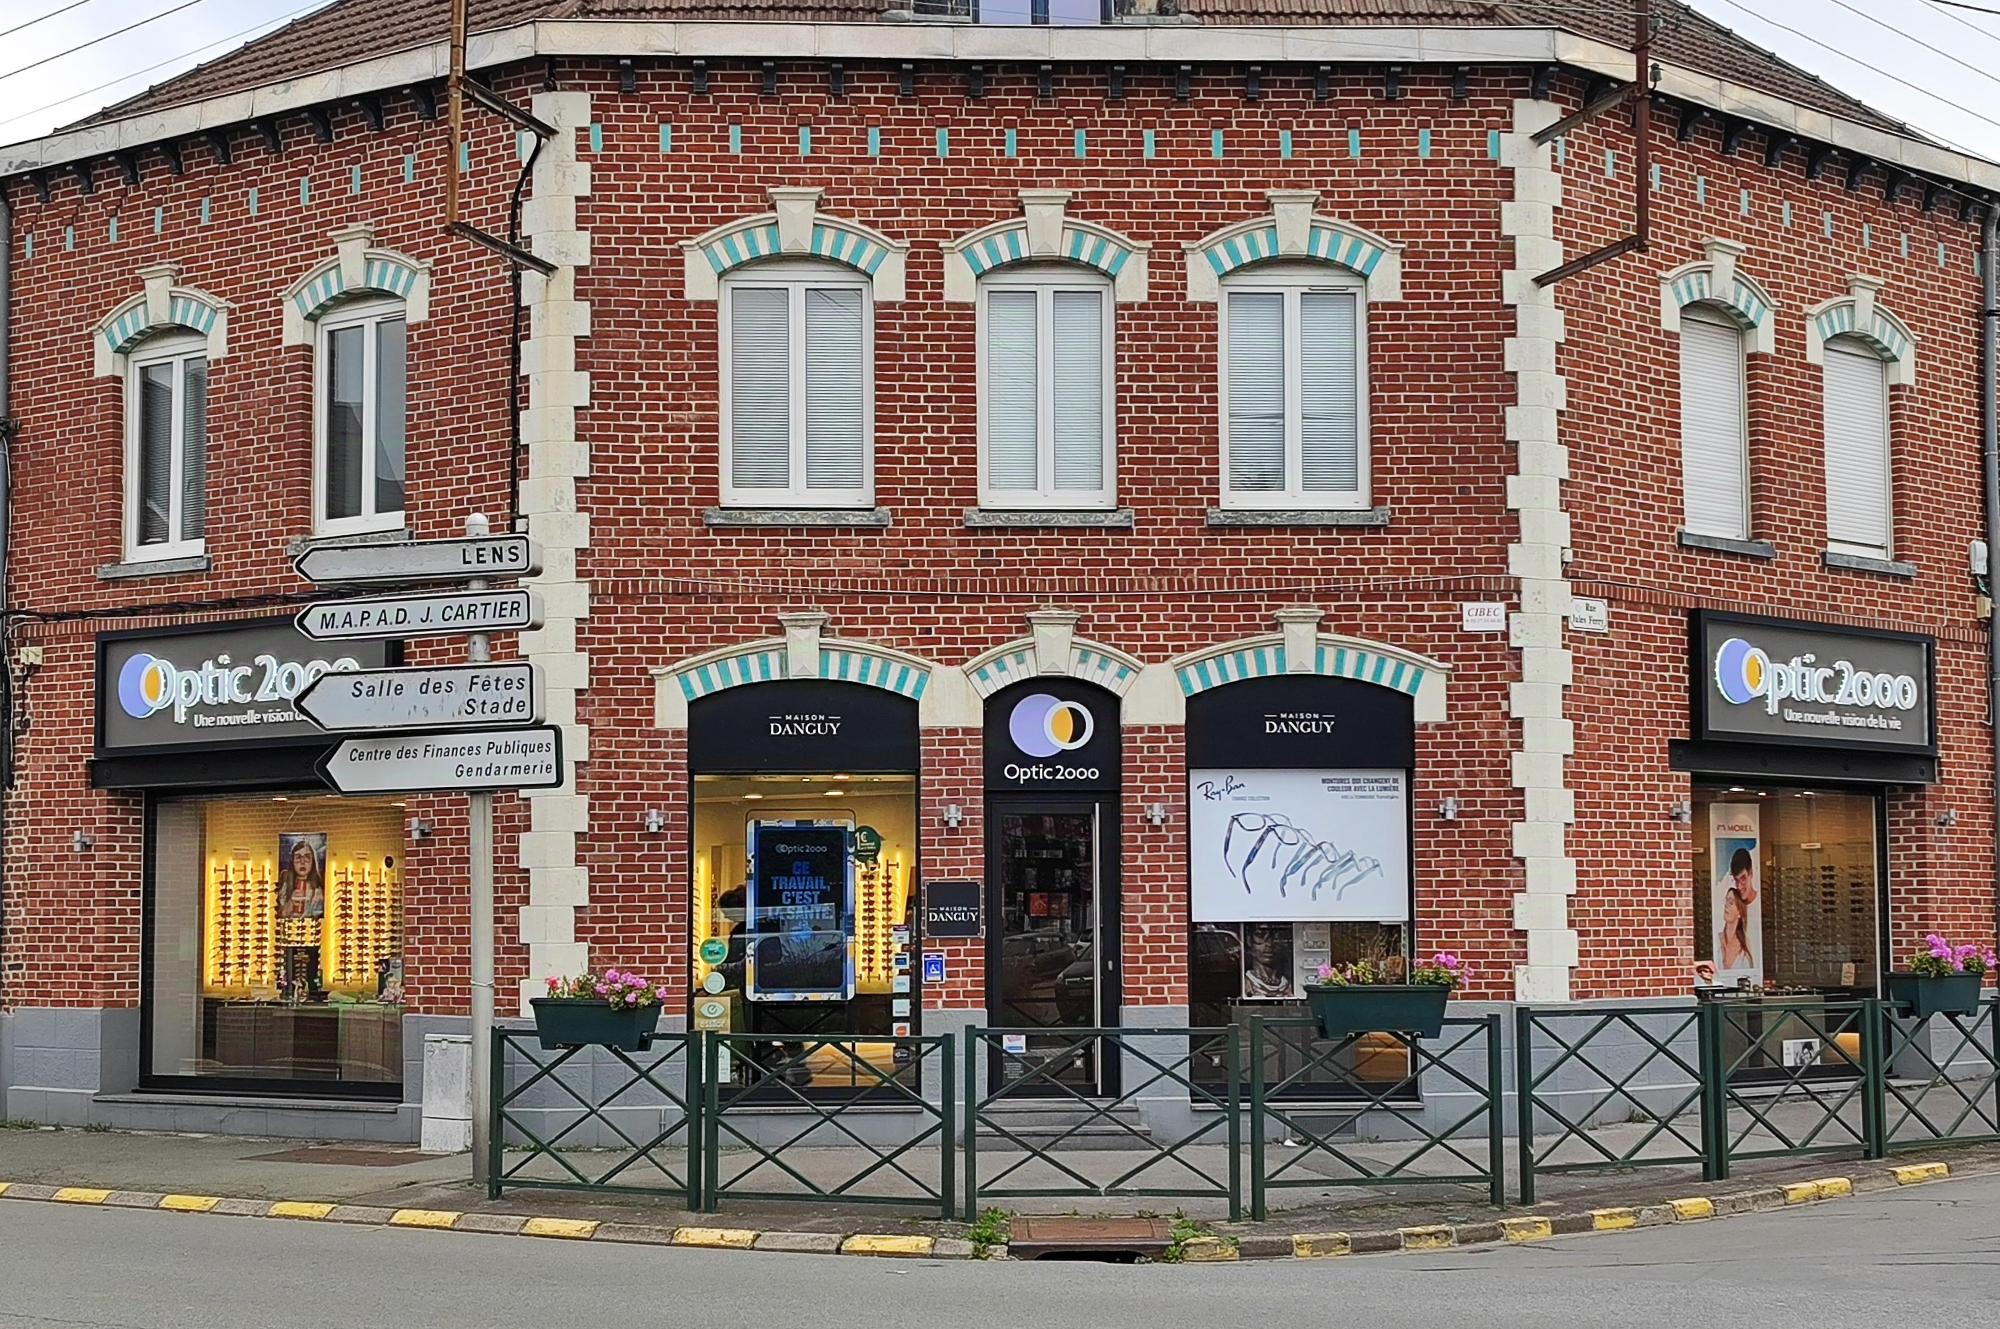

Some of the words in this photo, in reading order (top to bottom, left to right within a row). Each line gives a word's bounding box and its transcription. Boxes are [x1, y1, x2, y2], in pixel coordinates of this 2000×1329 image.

[462, 546, 520, 565] LENS
[420, 606, 433, 624] J.
[441, 601, 521, 622] CARTIER
[1467, 607, 1501, 617] CIBEC
[351, 679, 404, 698] Salle
[419, 678, 454, 695] des
[468, 674, 526, 693] Fêtes
[464, 697, 526, 715] Stade
[194, 714, 216, 727] Une
[216, 710, 261, 726] nouvelle
[262, 709, 294, 723] vision
[1265, 721, 1335, 733] DANGUY
[1784, 708, 1804, 722] Une
[1804, 711, 1840, 725] nouvelle
[1841, 713, 1866, 727] vision
[1867, 714, 1879, 728] de
[1879, 715, 1888, 728] la
[1889, 716, 1902, 730] vie
[770, 722, 841, 735] DANGUY
[350, 748, 391, 761] Centre
[396, 746, 418, 760] des
[423, 744, 481, 758] Finances
[486, 741, 551, 757] Publiques
[455, 760, 553, 777] Gendarmerie
[1196, 775, 1246, 801] Ray-Ban
[1727, 824, 1754, 832] MOREL
[782, 891, 820, 905] C'EST
[928, 912, 978, 922] DANGUY
